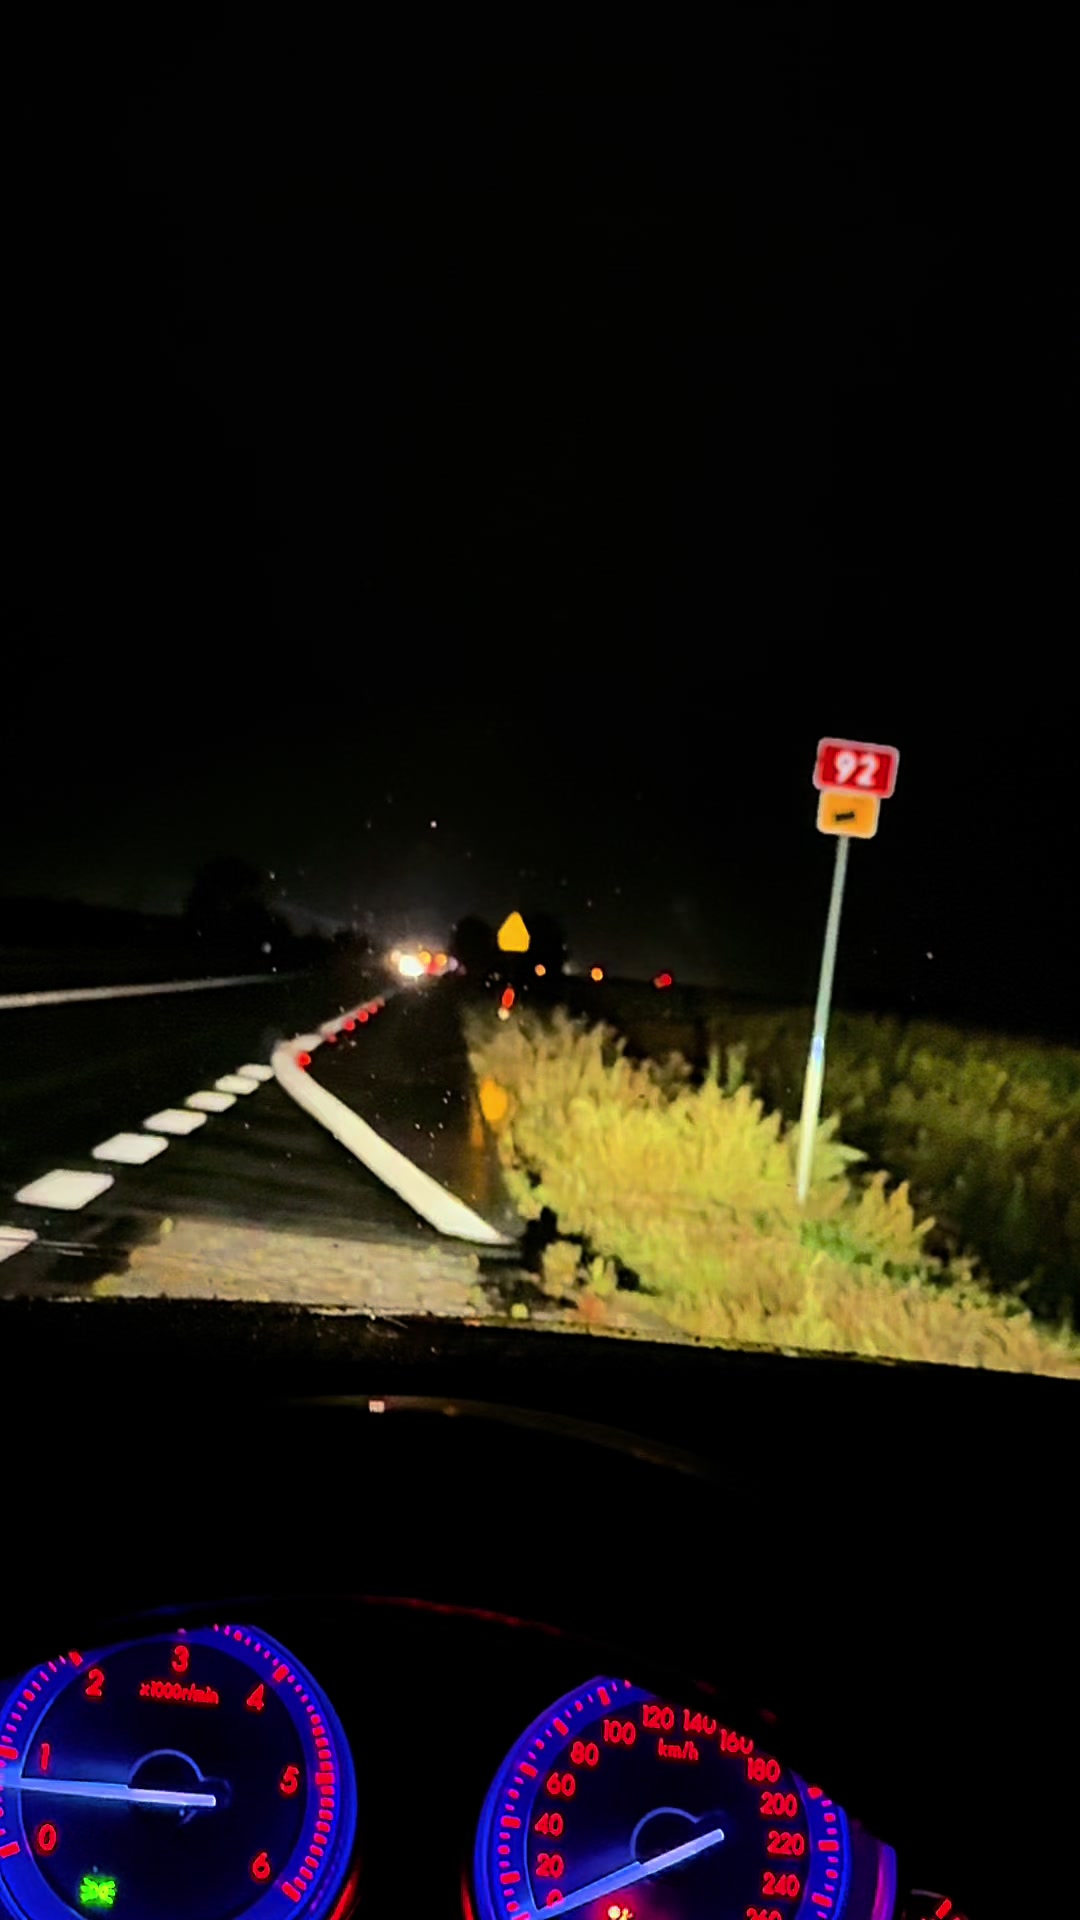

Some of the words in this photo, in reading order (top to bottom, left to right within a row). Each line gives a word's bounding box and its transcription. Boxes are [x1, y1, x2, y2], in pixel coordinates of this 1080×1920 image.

[834, 751, 880, 786] 92
[171, 1645, 189, 1673] 3
[85, 1669, 104, 1697] 2
[246, 1683, 265, 1710] 4
[642, 1704, 674, 1730] 120
[682, 1708, 717, 1735] 140
[603, 1719, 636, 1745] 100
[720, 1728, 753, 1755] 160
[40, 1743, 50, 1770] 1
[570, 1741, 599, 1766] 80
[658, 1737, 699, 1761] km/h
[280, 1766, 300, 1795] 5
[747, 1757, 781, 1783] 180
[546, 1772, 576, 1797] 60
[760, 1791, 798, 1817] 200
[38, 1823, 57, 1852] 0
[534, 1812, 564, 1837] 40
[767, 1830, 805, 1856] 220
[252, 1852, 271, 1880] 6
[535, 1853, 565, 1878] 20
[762, 1871, 800, 1897] 240
